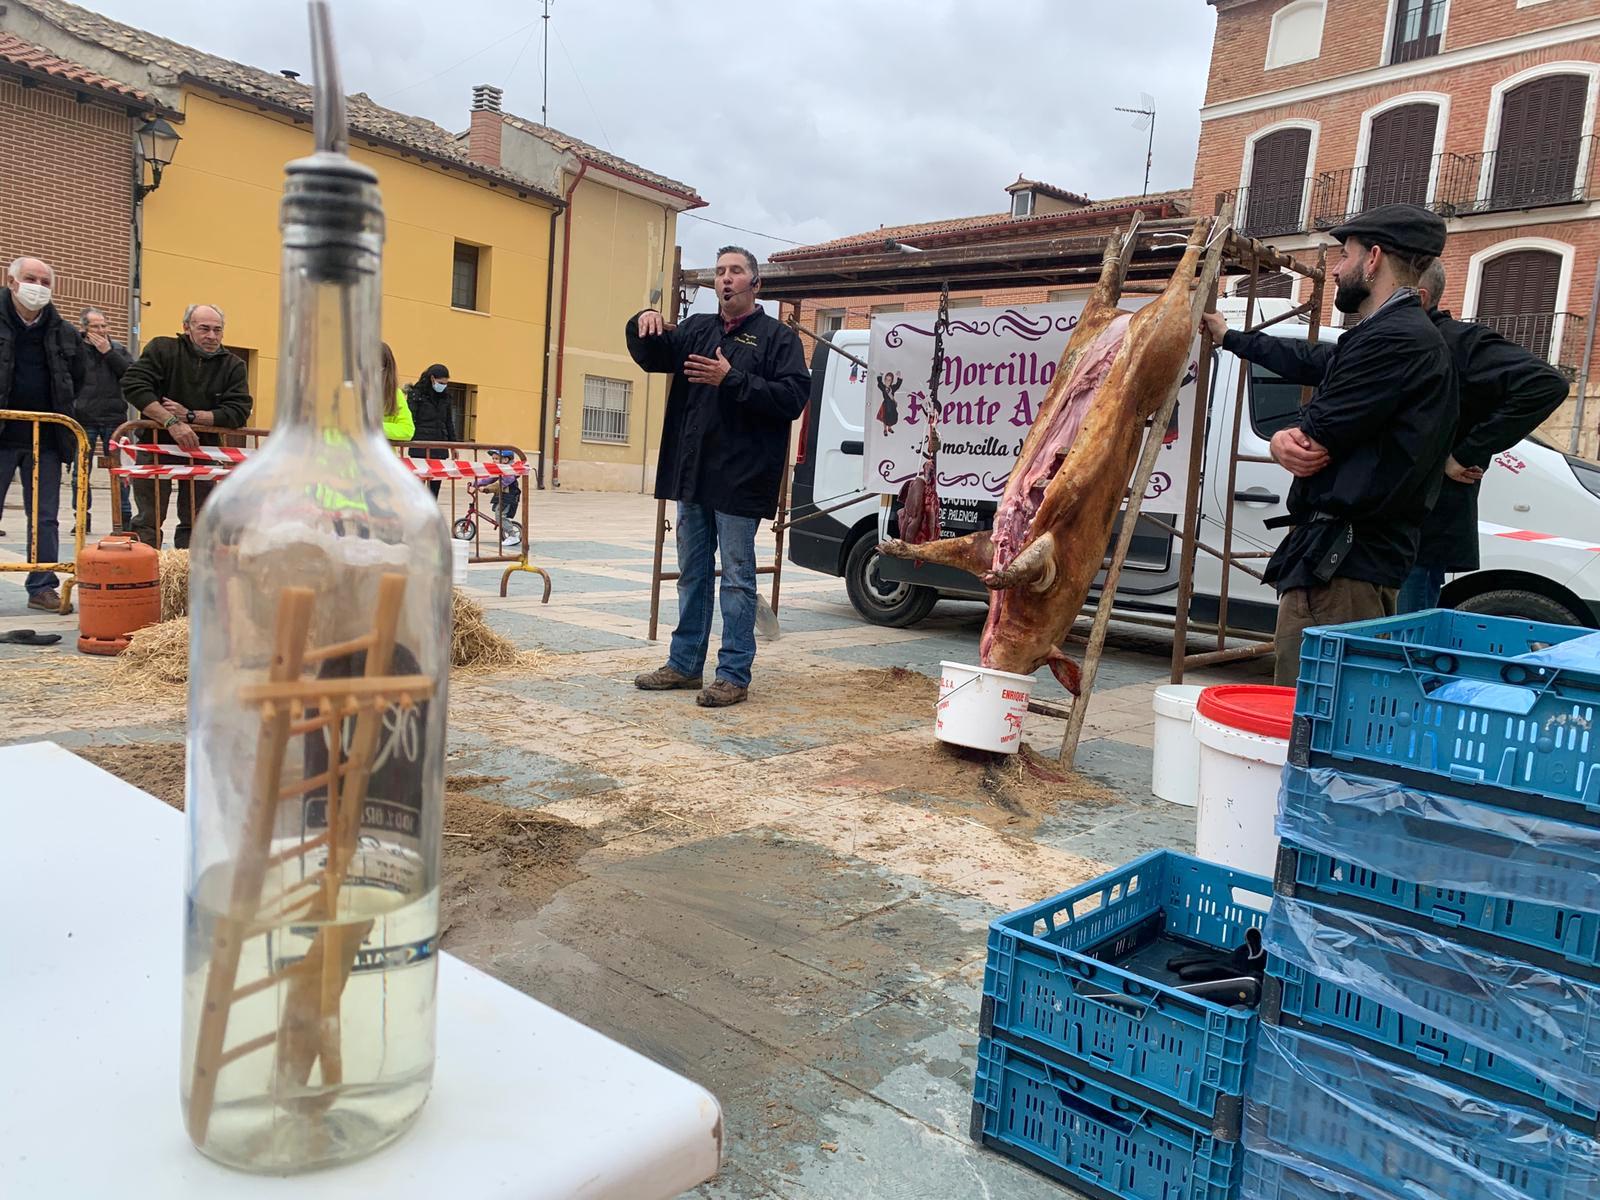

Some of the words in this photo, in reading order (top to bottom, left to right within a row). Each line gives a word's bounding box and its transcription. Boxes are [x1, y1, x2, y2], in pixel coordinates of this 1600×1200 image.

[904, 390, 1000, 426] Fente
[1008, 389, 1042, 427] A
[942, 436, 1010, 457] morcilla
[1013, 437, 1025, 457] d
[948, 508, 978, 523] PALENCIA
[1001, 689, 1024, 702] ENRIQUE
